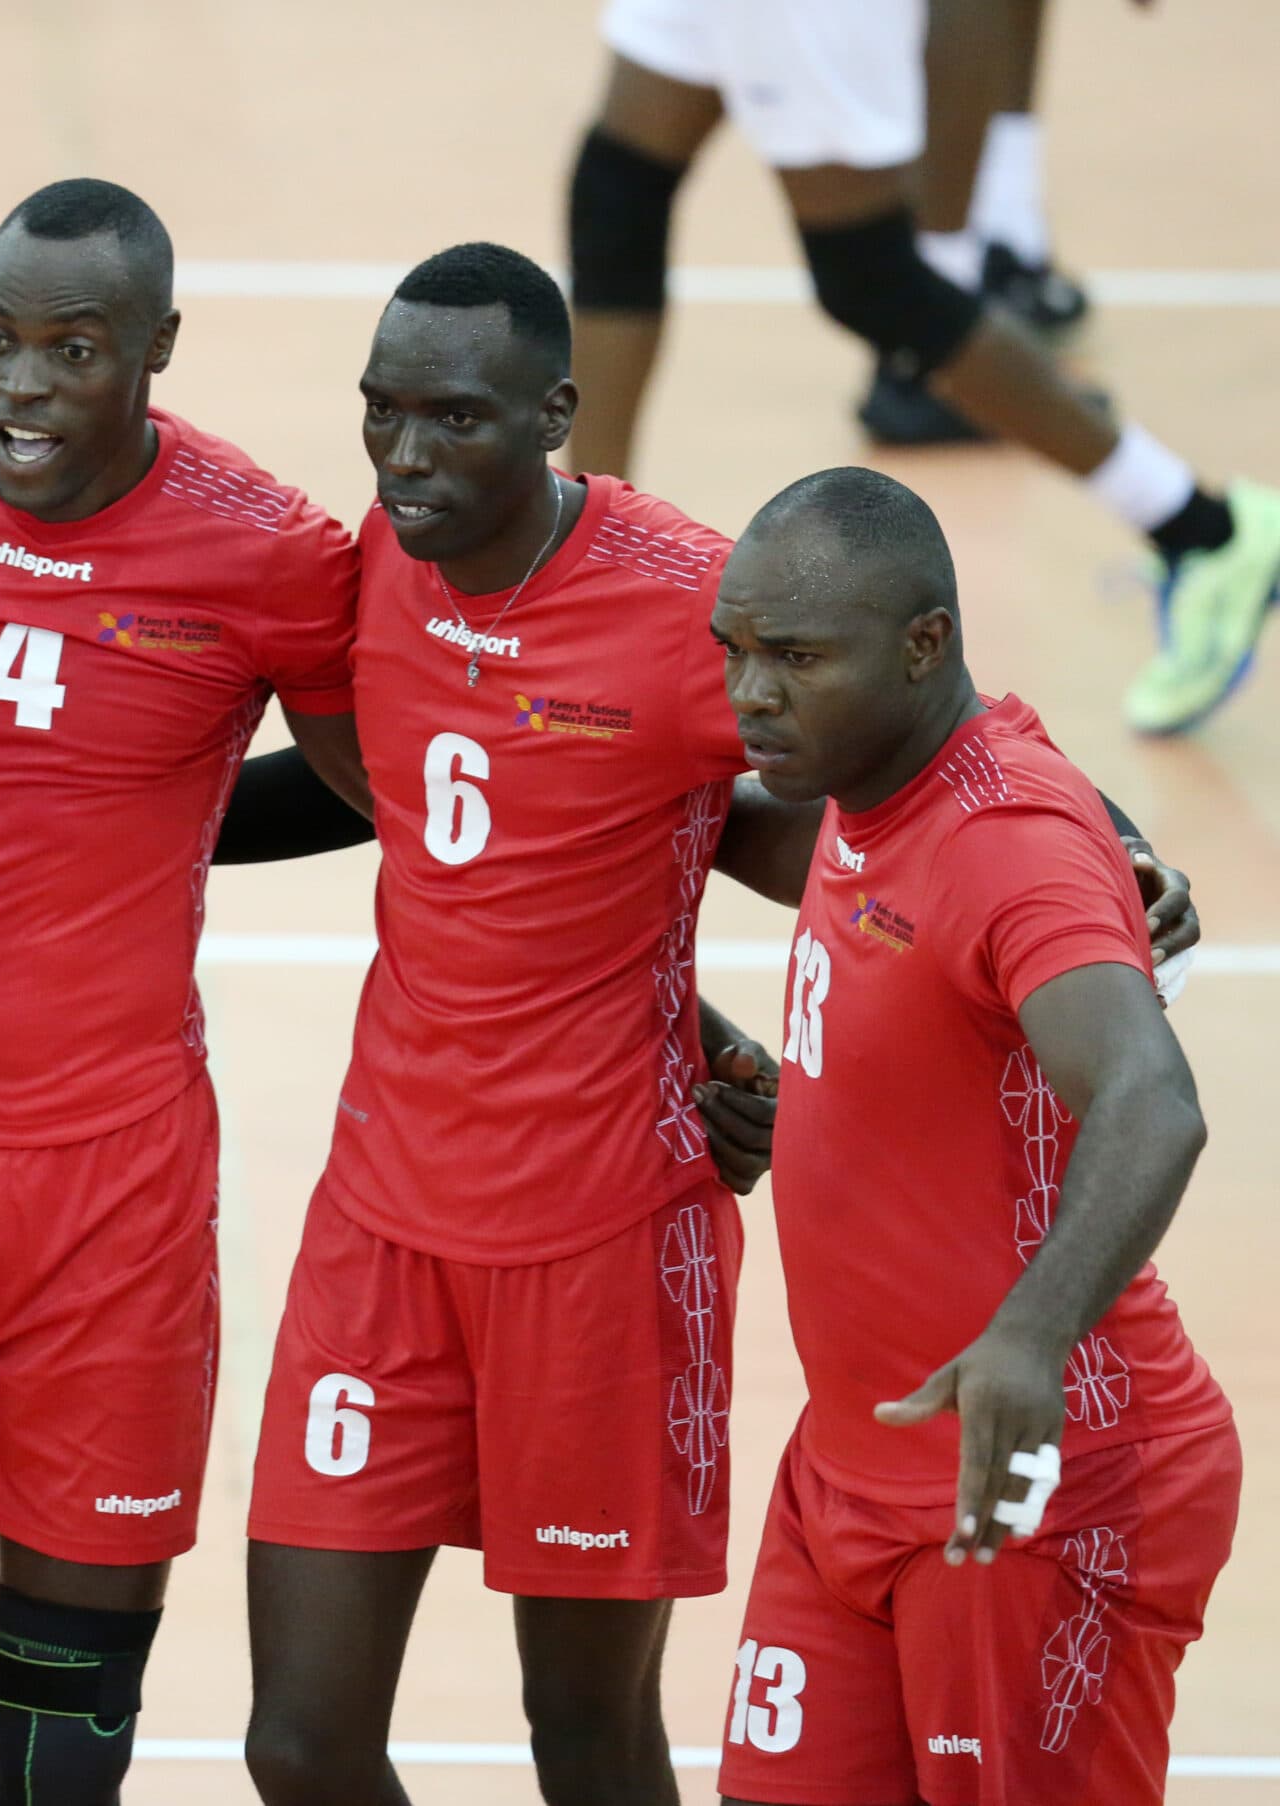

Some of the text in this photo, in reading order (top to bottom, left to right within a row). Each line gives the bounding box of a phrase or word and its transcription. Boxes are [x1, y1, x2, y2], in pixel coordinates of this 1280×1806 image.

[425, 617, 520, 658] uhlsport
[423, 731, 492, 866] 6
[783, 927, 831, 1079] 13
[305, 1373, 375, 1477] 6
[95, 1488, 182, 1518] uhlsport
[536, 1525, 631, 1551] uhlsport
[728, 1638, 807, 1753] 13
